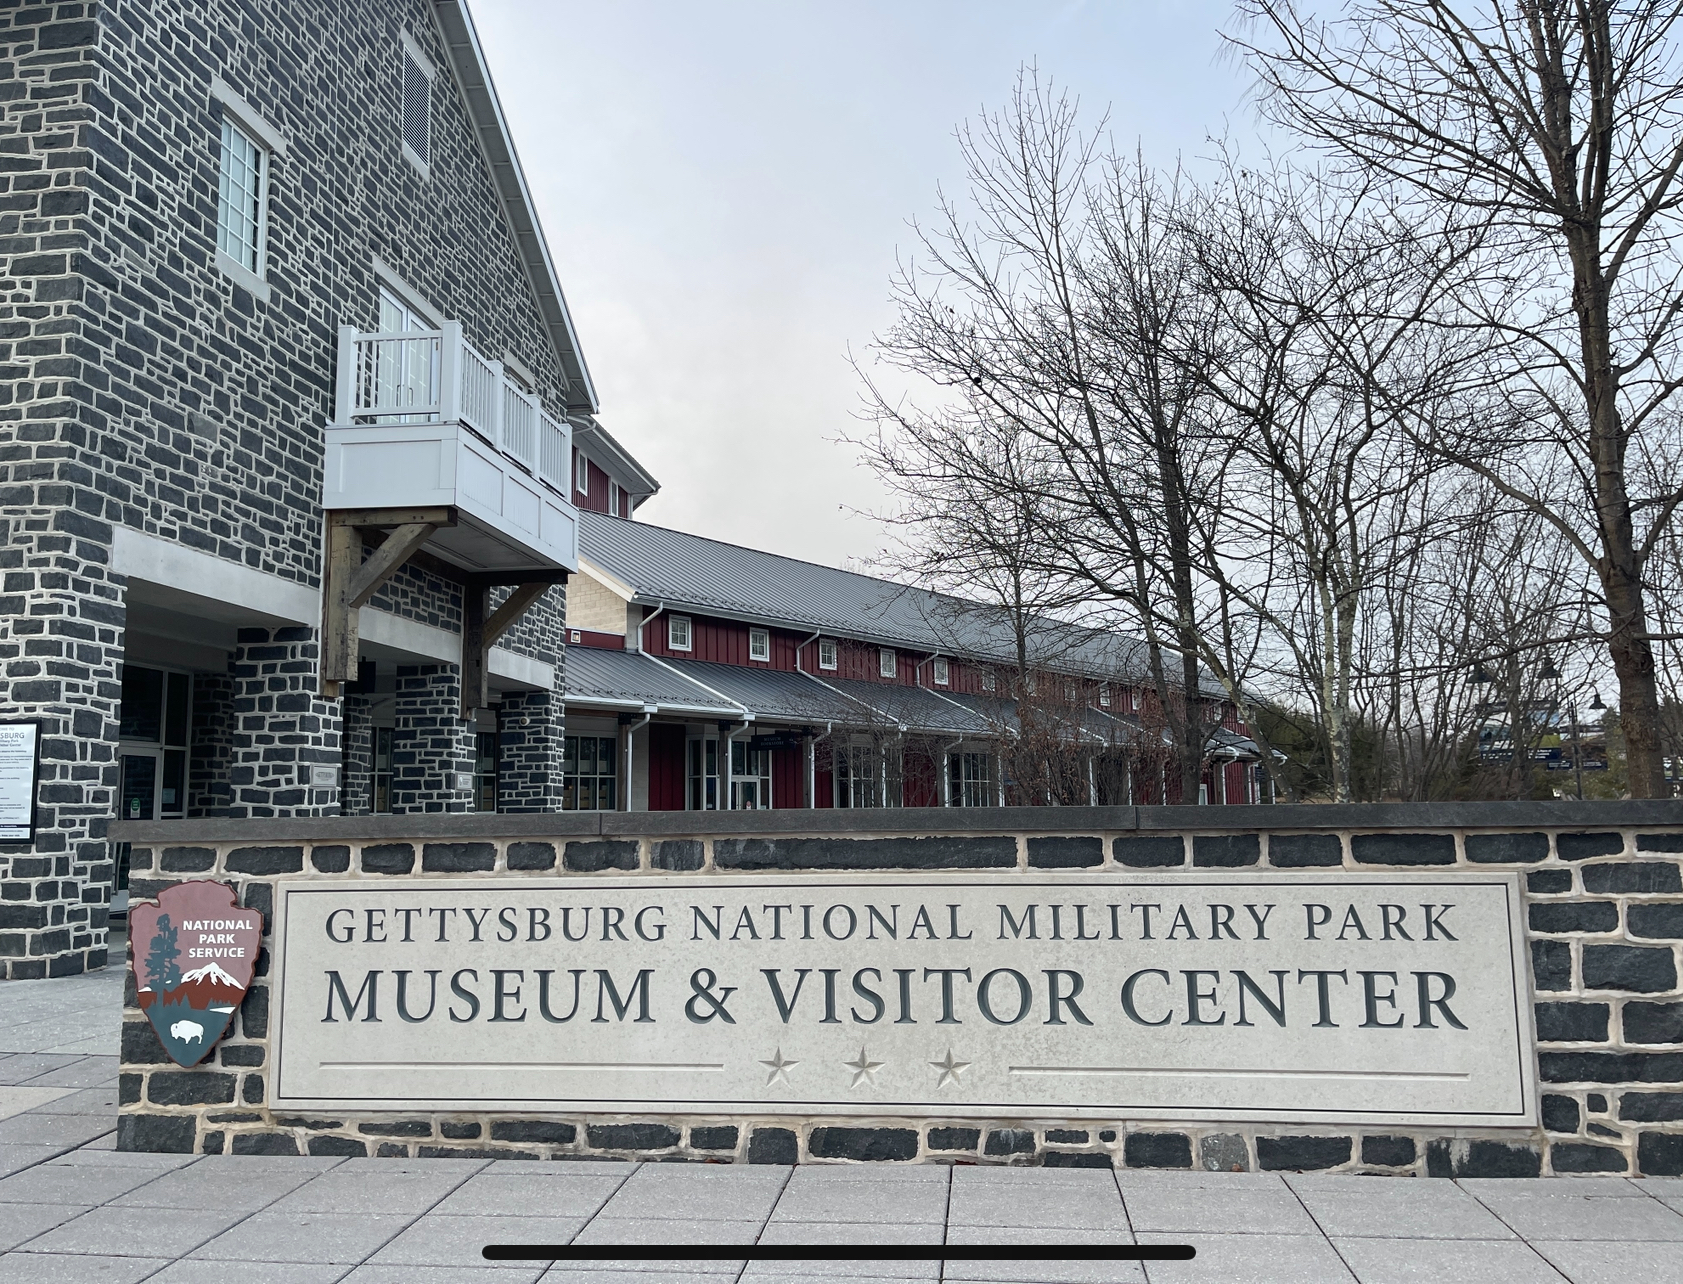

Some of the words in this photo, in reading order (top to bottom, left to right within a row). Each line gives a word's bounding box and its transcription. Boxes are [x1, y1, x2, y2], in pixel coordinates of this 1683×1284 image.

[183, 919, 253, 931] NATIONAL
[326, 906, 667, 943] GETTYSBURG
[690, 904, 972, 941] NATIONAL
[996, 903, 1277, 941] MILITARY
[1303, 903, 1459, 942] PARK
[199, 933, 236, 944] PARK
[188, 947, 245, 959] SERVICE
[320, 968, 656, 1024] MUSEUM
[684, 967, 739, 1025] &
[759, 966, 1094, 1026] VISITOR
[1120, 968, 1469, 1030] CENTER
